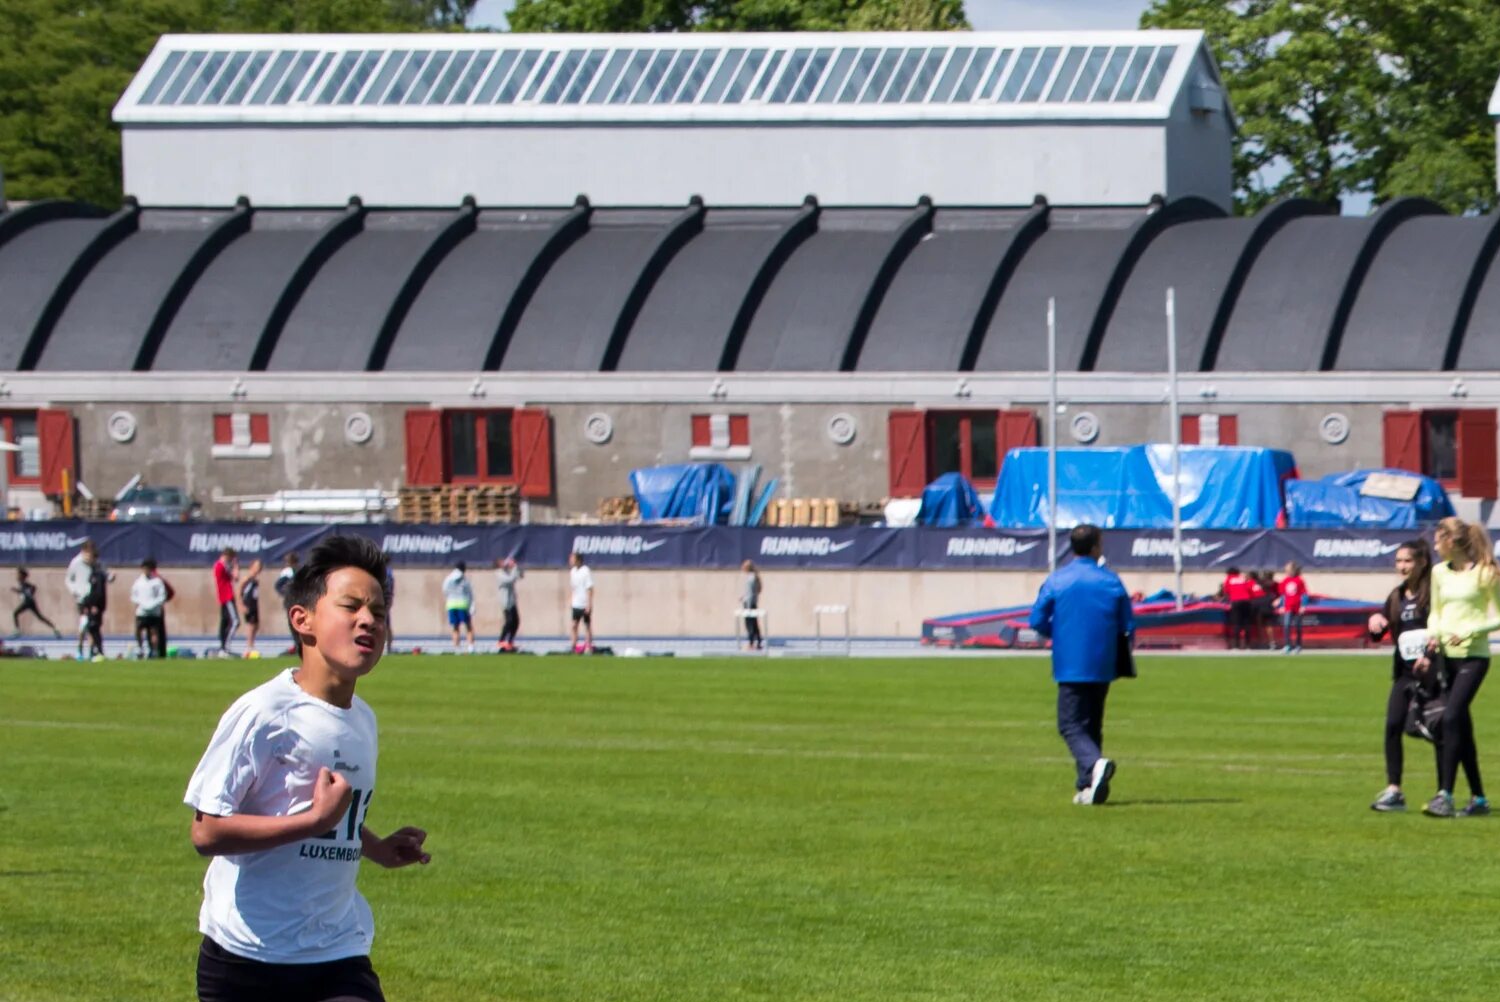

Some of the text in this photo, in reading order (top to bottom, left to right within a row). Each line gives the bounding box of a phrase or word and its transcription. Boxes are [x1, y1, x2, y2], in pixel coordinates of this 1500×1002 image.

[189, 534, 261, 552] RUNNING
[381, 535, 452, 553] RUNNING
[572, 536, 642, 554] RUNNING
[760, 537, 830, 555] RUNNING
[946, 538, 1016, 556] RUNNING
[1131, 538, 1200, 557] RUNNG
[1313, 539, 1381, 557] RUNNING
